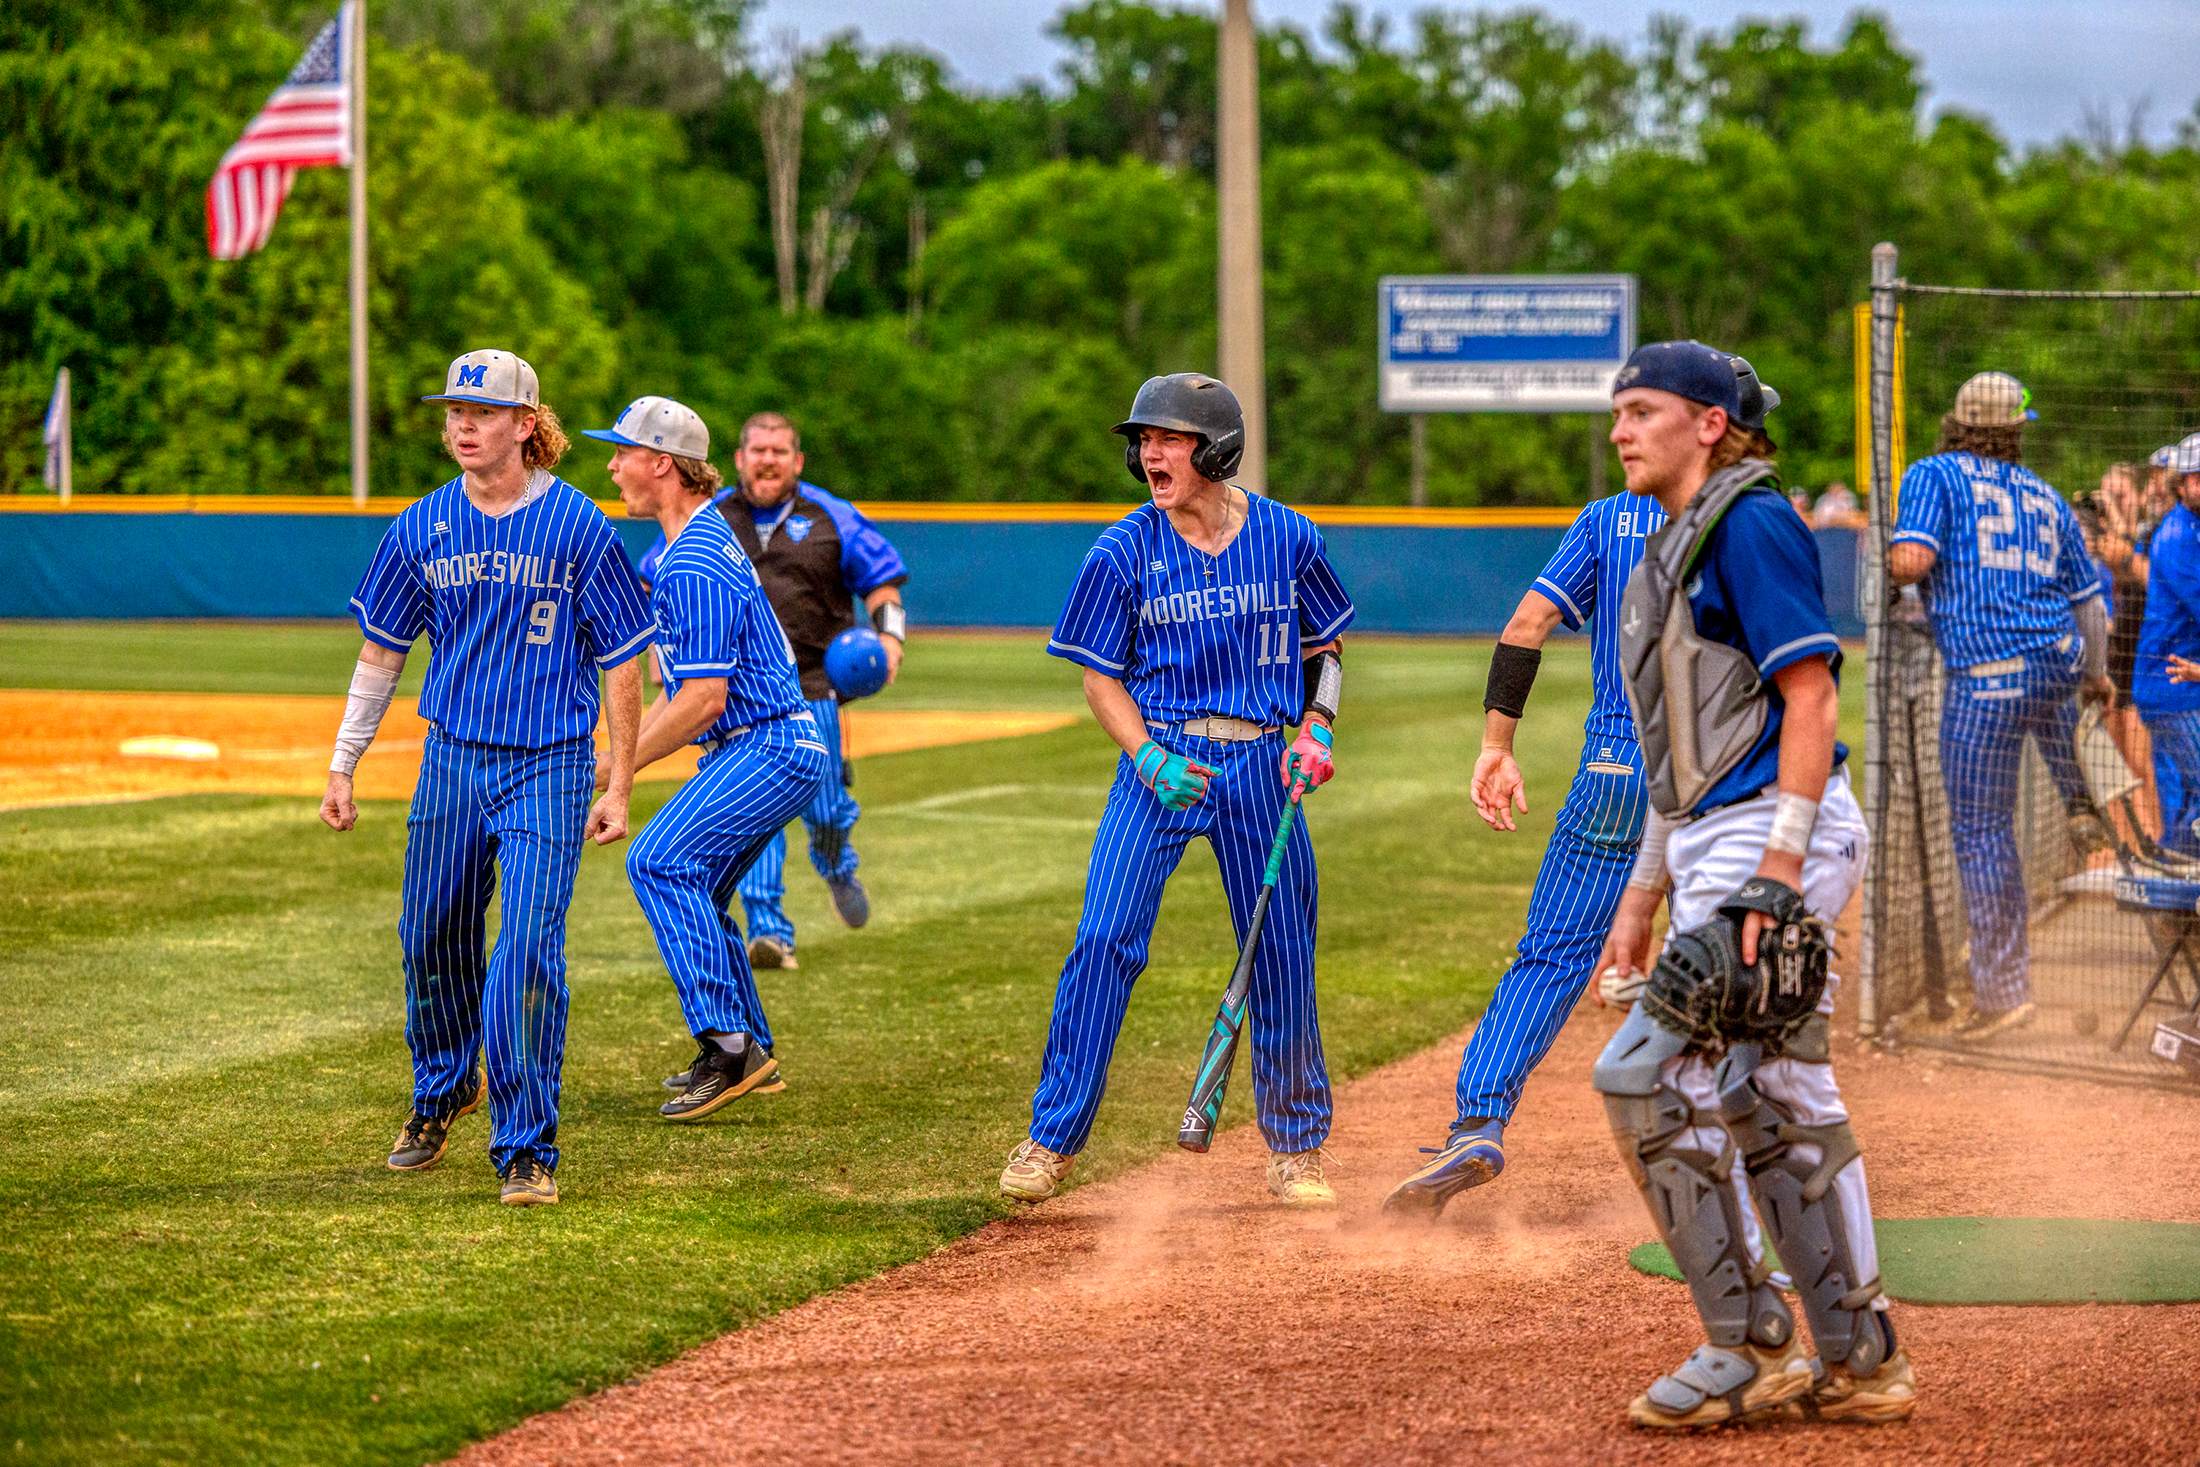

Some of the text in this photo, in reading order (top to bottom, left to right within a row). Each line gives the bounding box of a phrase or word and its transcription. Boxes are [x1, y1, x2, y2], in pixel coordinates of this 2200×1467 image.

[456, 364, 488, 388] M
[1616, 511, 1670, 538] BLU
[1970, 480, 2060, 578] 23
[421, 550, 575, 594] MOORESVILLE
[525, 600, 558, 645] 9
[1139, 579, 1298, 627] MOORESVILLE
[1257, 622, 1290, 666] 11
